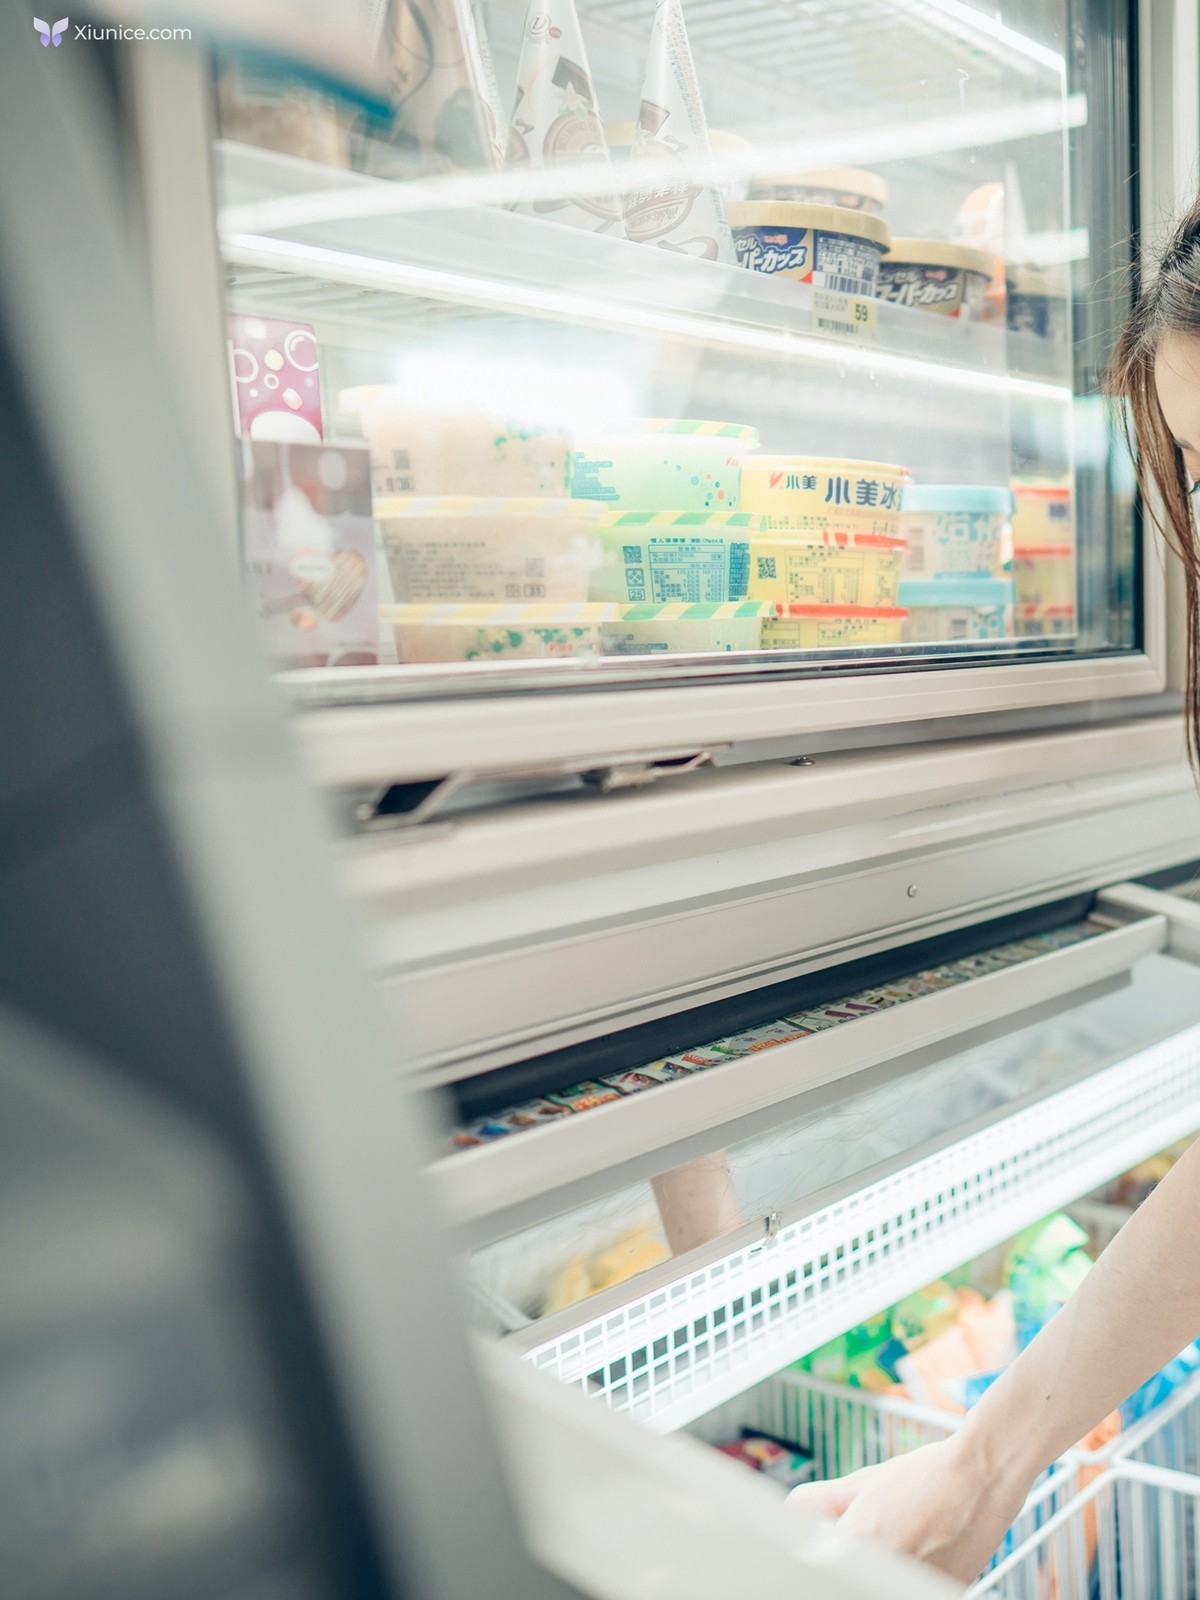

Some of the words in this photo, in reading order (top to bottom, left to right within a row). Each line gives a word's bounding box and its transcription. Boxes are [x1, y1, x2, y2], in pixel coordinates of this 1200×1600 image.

[854, 303, 869, 322] 59
[786, 474, 817, 490] 小美
[824, 476, 903, 511] 小美冰
[631, 590, 643, 600] 25
